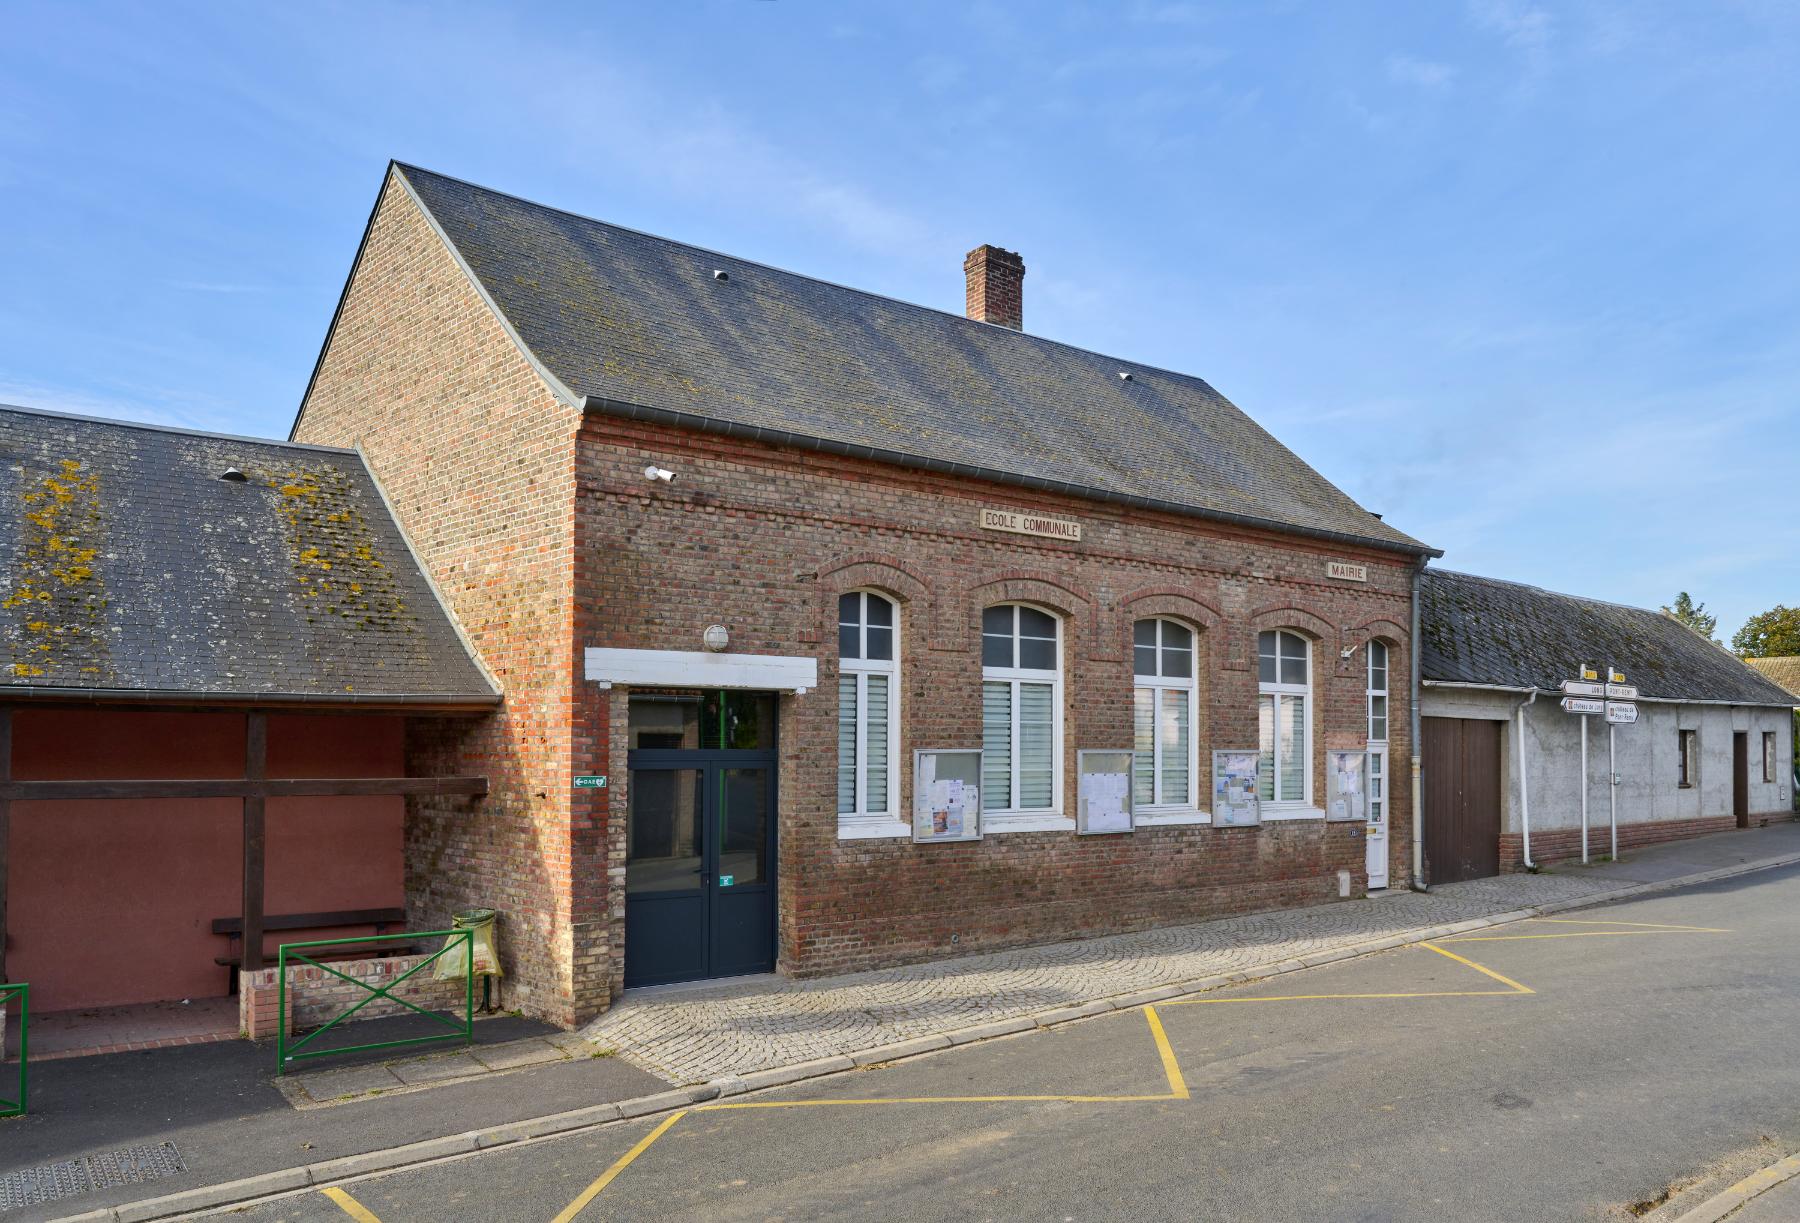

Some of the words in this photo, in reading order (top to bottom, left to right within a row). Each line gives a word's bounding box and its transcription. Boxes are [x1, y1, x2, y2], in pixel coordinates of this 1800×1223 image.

[985, 512, 1017, 529] ECOLE
[1023, 518, 1078, 537] COMMUNALE
[1332, 565, 1362, 578] MAIRIE
